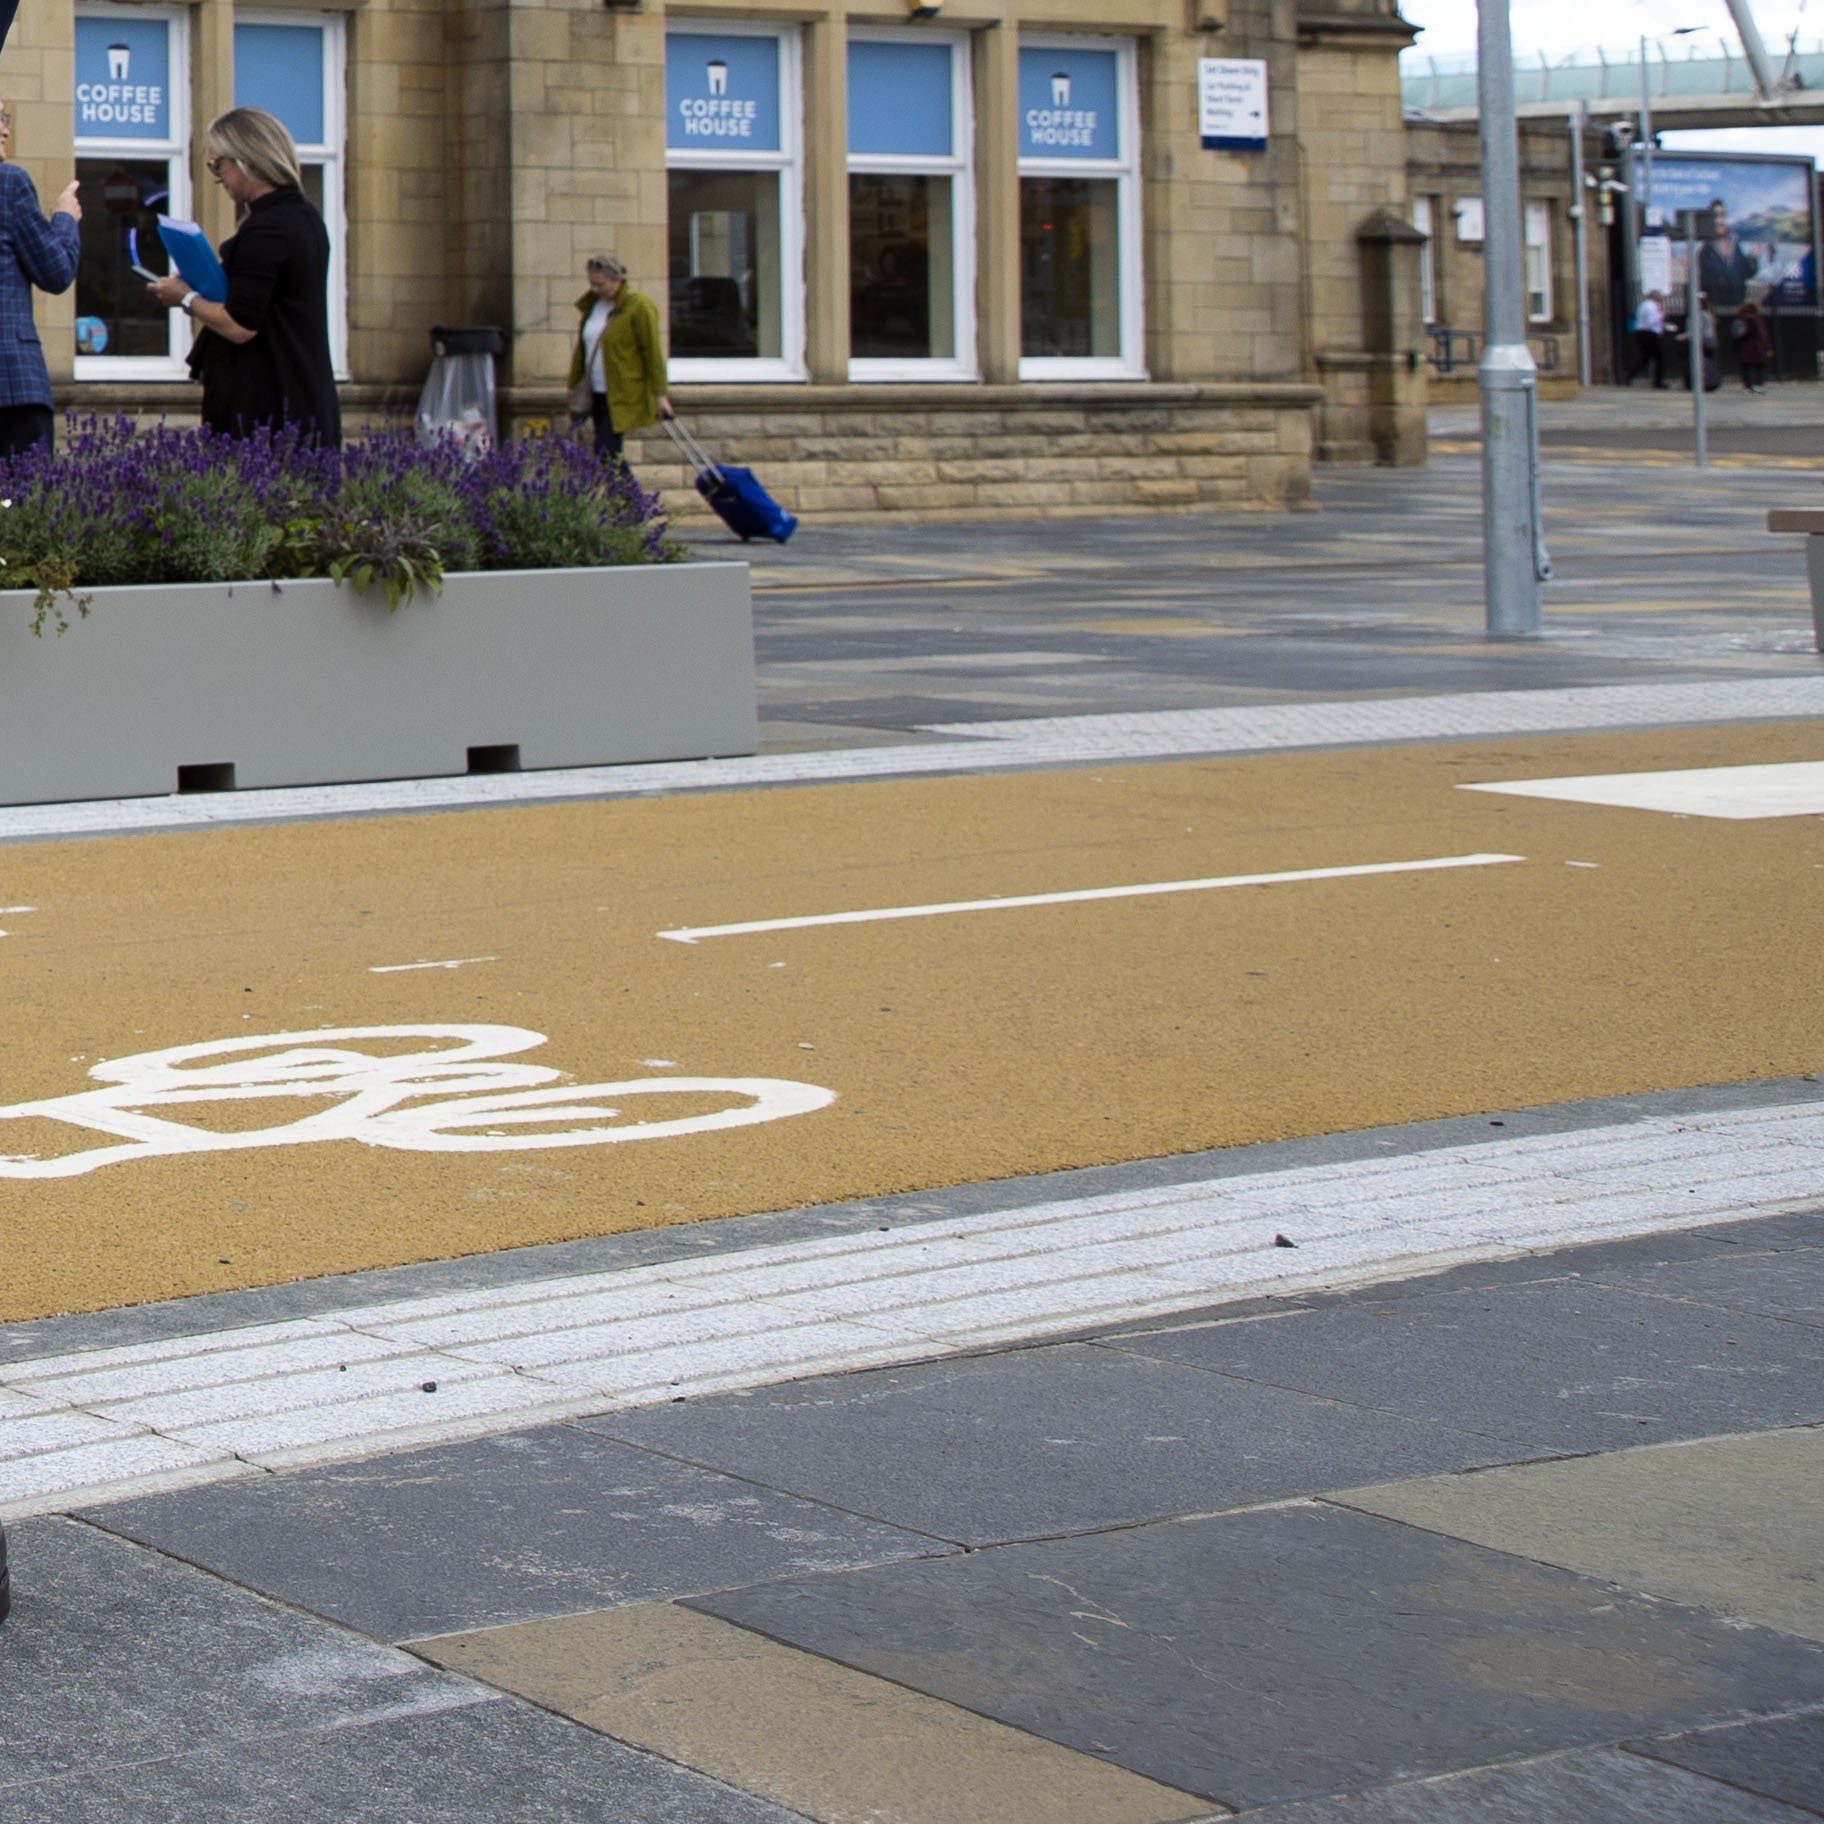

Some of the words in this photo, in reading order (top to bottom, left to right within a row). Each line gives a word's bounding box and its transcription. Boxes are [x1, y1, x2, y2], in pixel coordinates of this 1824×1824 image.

[77, 83, 162, 105] COFFEE
[81, 102, 157, 124] HOUSE
[679, 98, 757, 118] COFFEE
[684, 117, 753, 136] HOUSE
[1026, 109, 1098, 129] COFFEE
[1031, 127, 1093, 146] HOUSE
